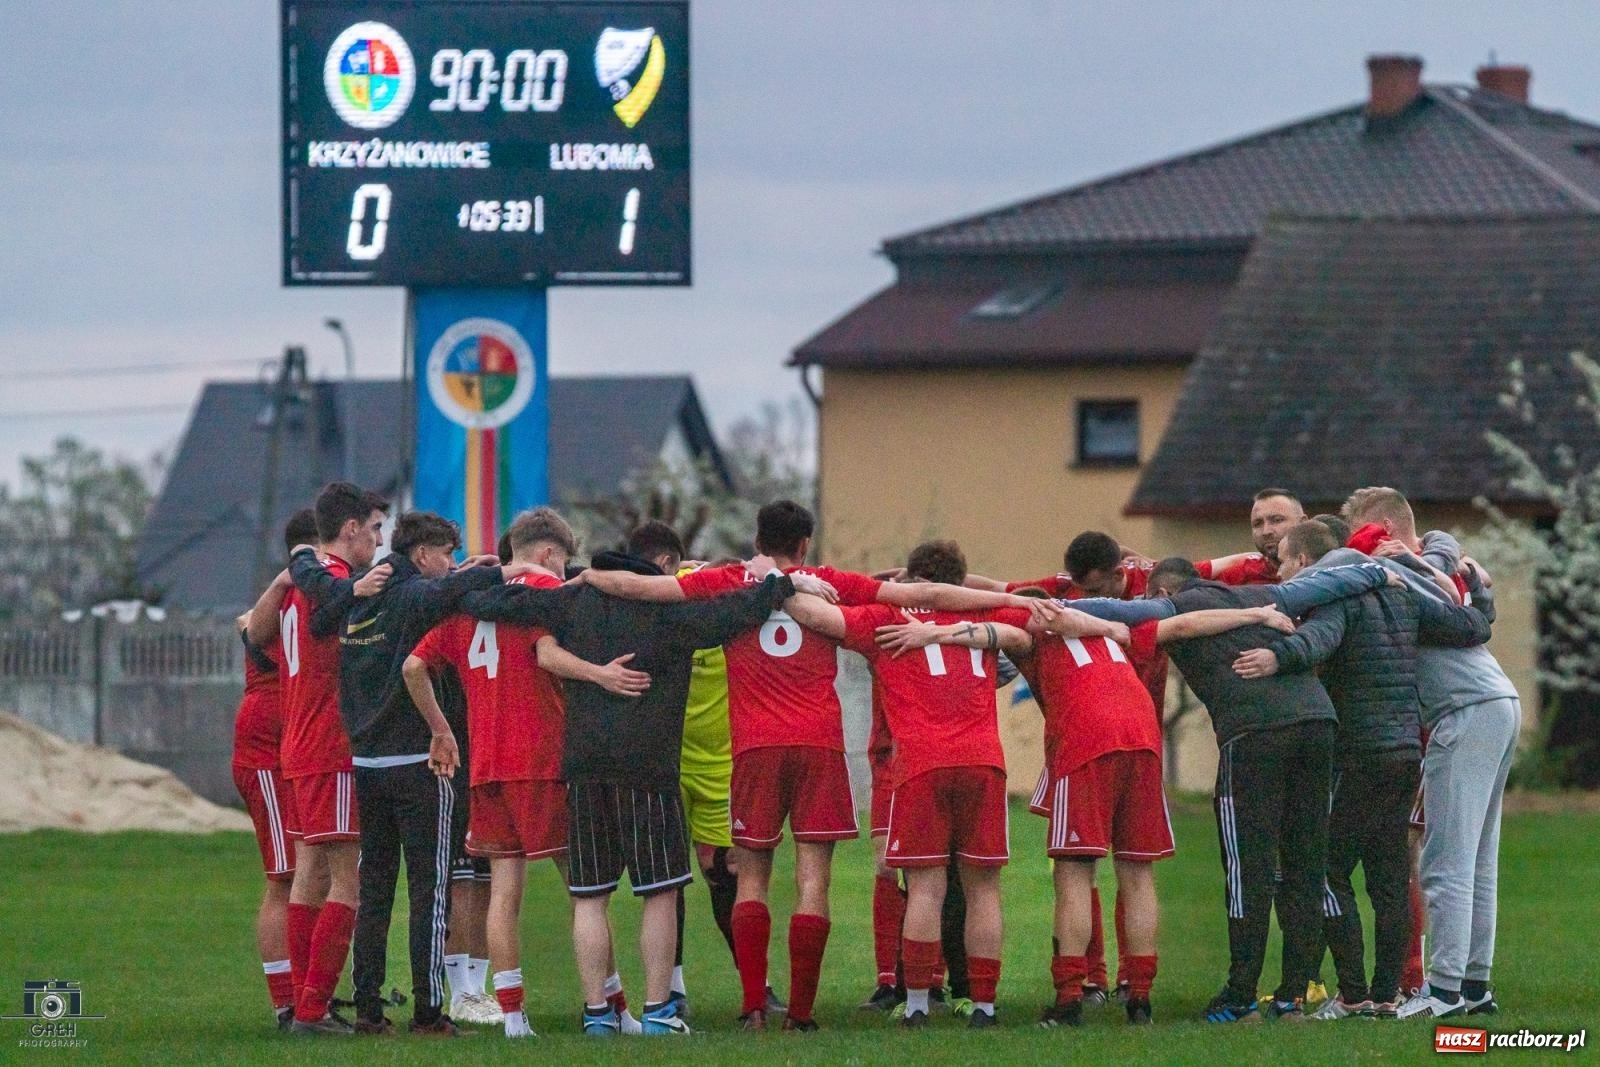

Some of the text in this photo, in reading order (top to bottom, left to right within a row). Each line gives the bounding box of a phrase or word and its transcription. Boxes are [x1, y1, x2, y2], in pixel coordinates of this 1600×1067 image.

[429, 49, 568, 111] 90:00
[308, 138, 491, 168] KRZYŻANOWICE
[549, 143, 655, 170] LUBOMIA
[346, 184, 392, 260] 0
[618, 188, 641, 255] 1
[280, 603, 299, 677] 0
[468, 620, 500, 679] 4
